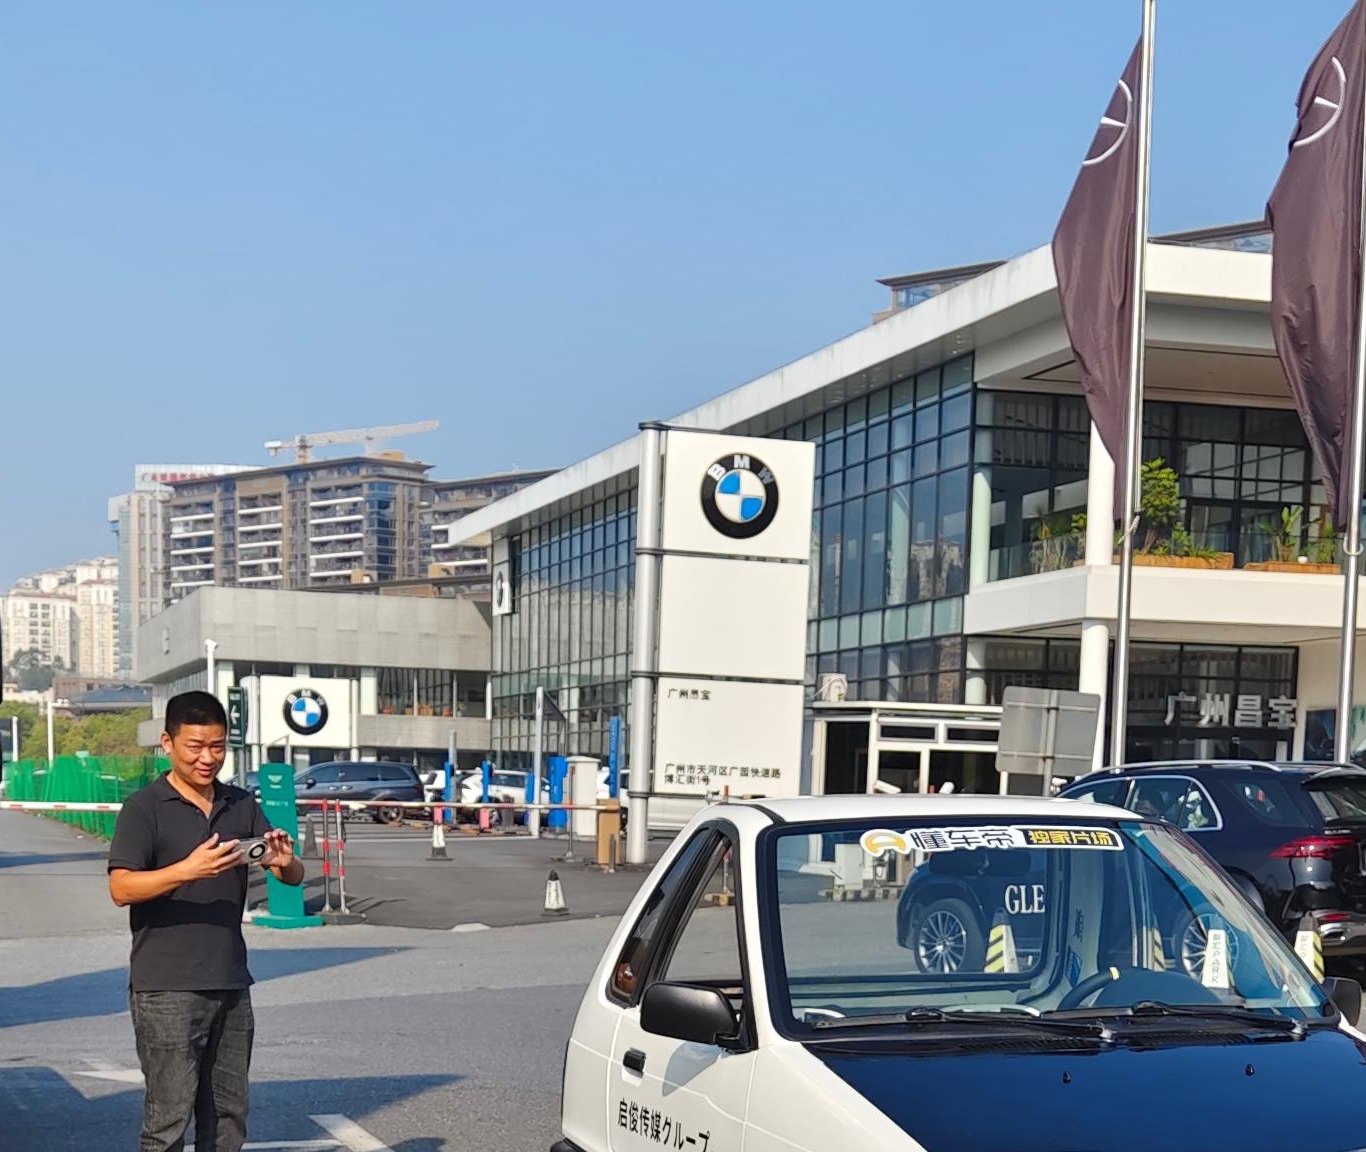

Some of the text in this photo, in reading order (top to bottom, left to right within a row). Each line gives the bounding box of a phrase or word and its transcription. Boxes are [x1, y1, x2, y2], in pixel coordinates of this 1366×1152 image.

[707, 454, 775, 485] BMW
[1164, 691, 1297, 729] 广州昌宝
[911, 828, 1016, 850] 懂车帝
[1029, 829, 1114, 847] 独家片场
[1004, 884, 1046, 915] GLE
